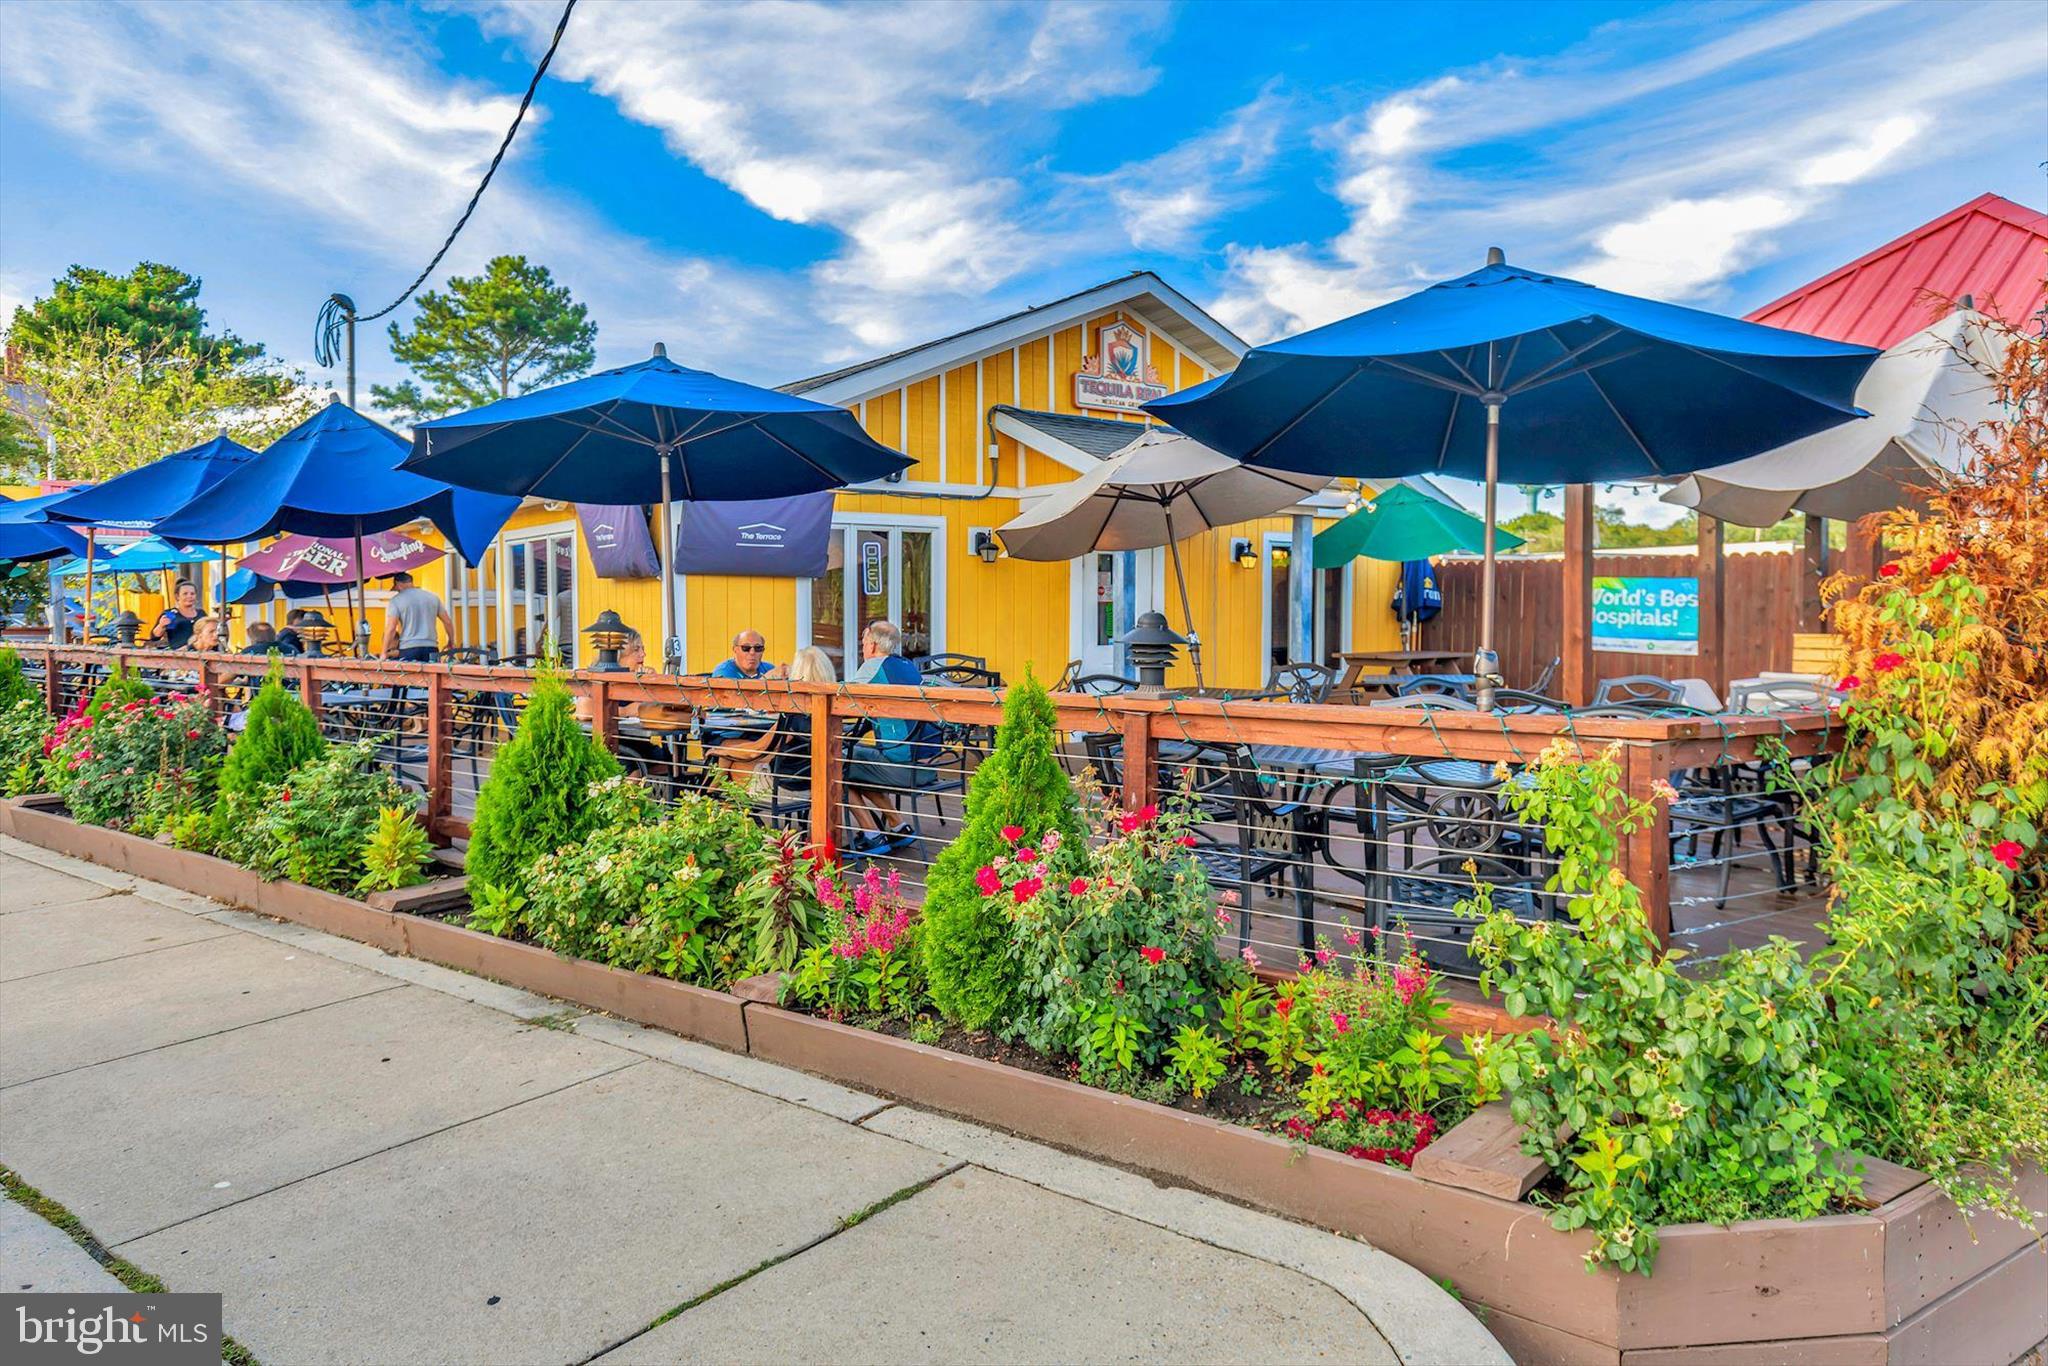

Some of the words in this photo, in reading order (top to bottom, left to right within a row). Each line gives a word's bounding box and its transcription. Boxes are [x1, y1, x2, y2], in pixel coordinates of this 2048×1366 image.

[1080, 378, 1134, 399] TEQUILA
[741, 532, 755, 540] The
[755, 532, 782, 541] Terrace
[867, 545, 879, 592] OPEN
[1592, 607, 1679, 629] ospitals!
